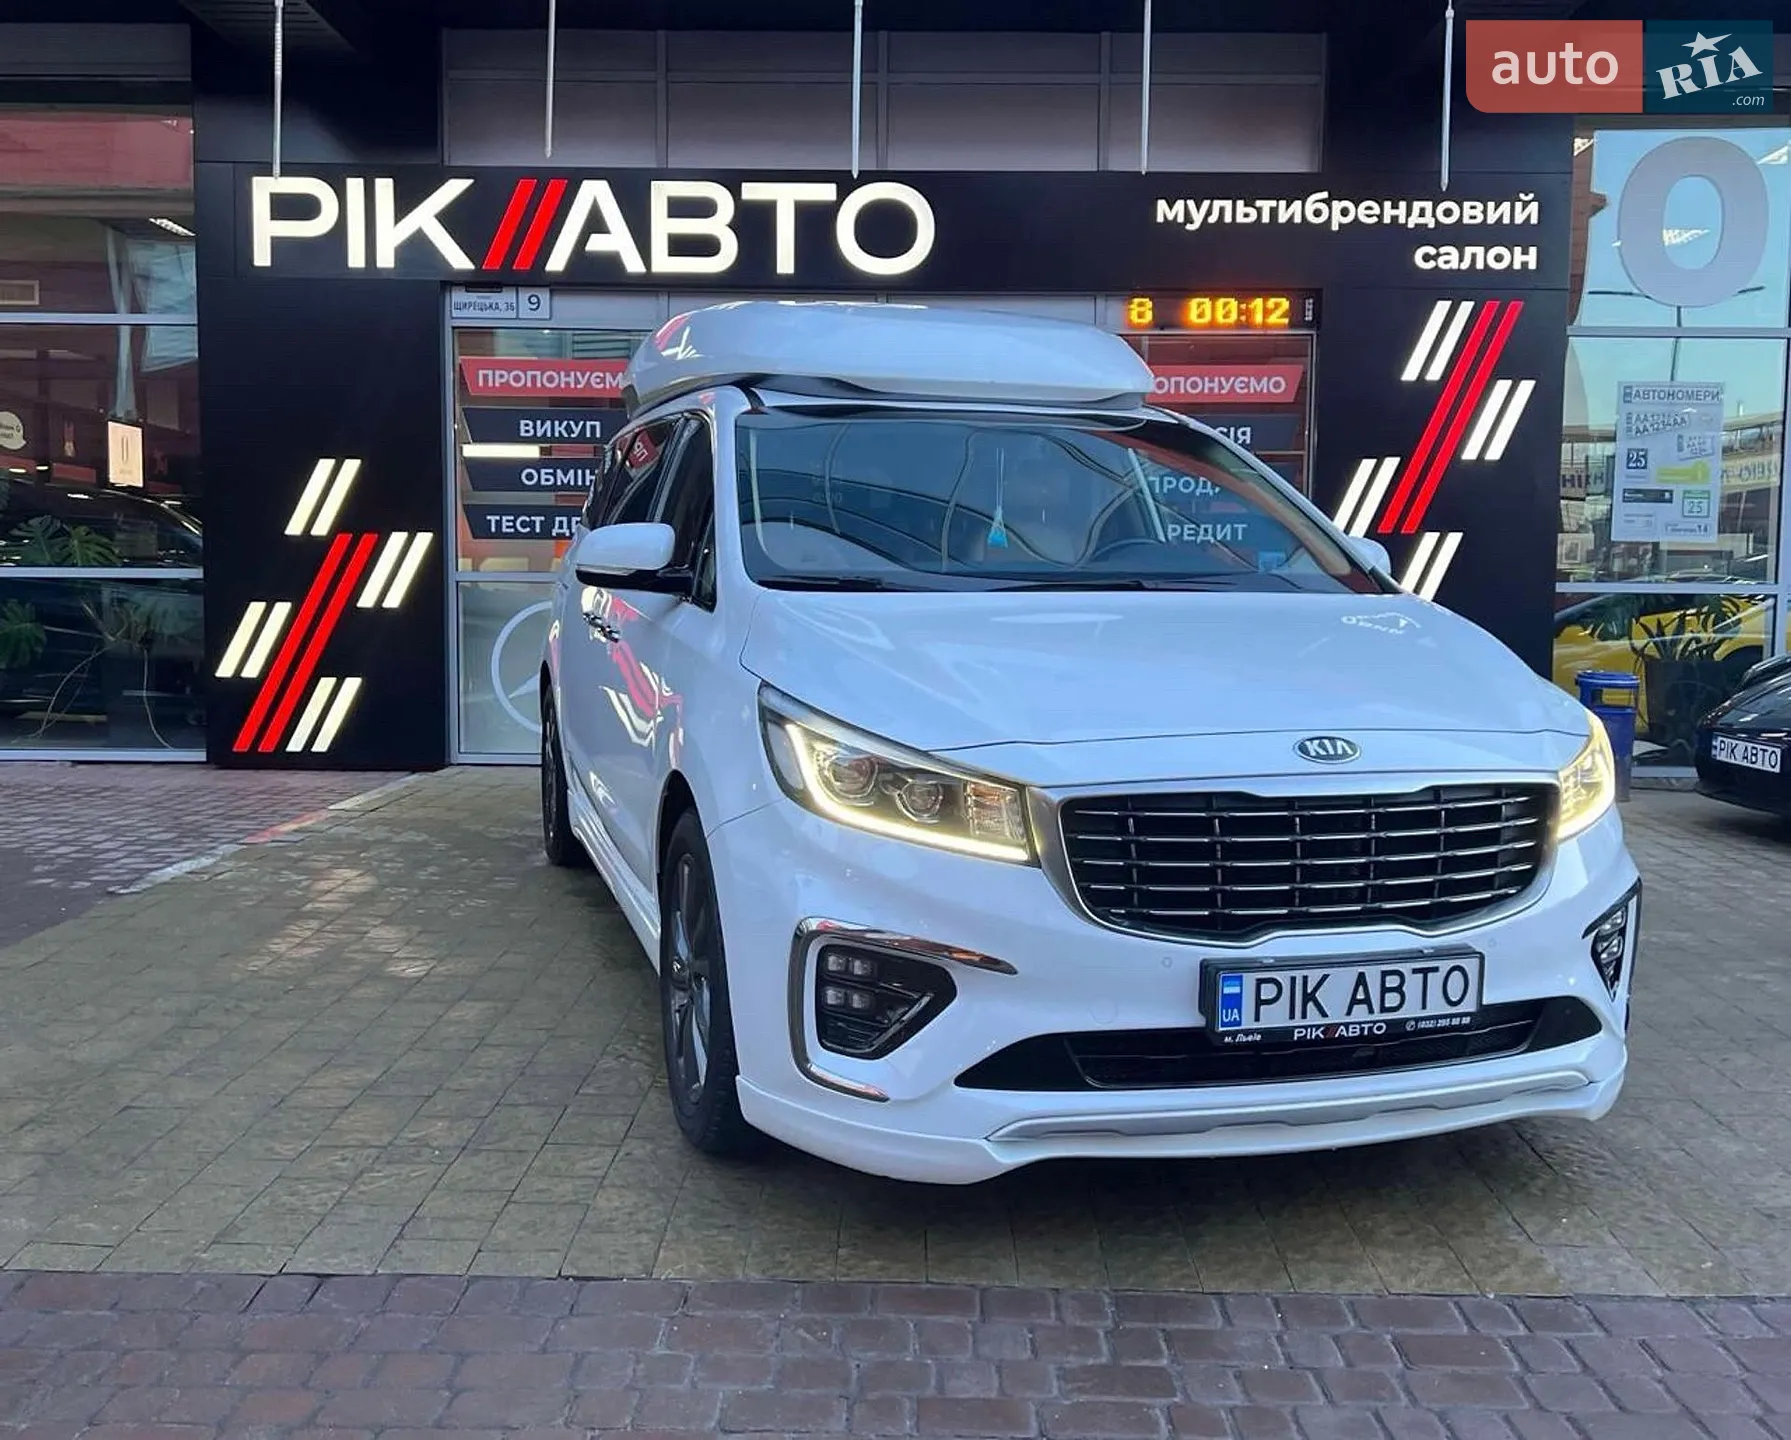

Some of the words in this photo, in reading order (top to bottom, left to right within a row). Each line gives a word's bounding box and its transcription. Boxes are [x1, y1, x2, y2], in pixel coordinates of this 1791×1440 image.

[1156, 191, 1539, 231] мультибрендовий
[1413, 244, 1538, 270] салон
[527, 293, 542, 311] 9
[1128, 297, 1154, 324] 8
[1187, 297, 1291, 324] 00:12
[478, 369, 625, 390] ПРОПОНУЄМ
[1154, 376, 1287, 394] ОПОНУЄМО
[1633, 388, 1721, 402] АВТОНОМЕРИ
[519, 419, 602, 439] ВИКУП
[1628, 450, 1646, 467] 25
[486, 515, 545, 534] ТЕСТ
[1166, 523, 1249, 545] РЕДИТ
[1304, 740, 1354, 756] KIA
[1253, 973, 1331, 1023] РІК
[1346, 964, 1470, 1017] АВТО
[1222, 1008, 1240, 1023] UA
